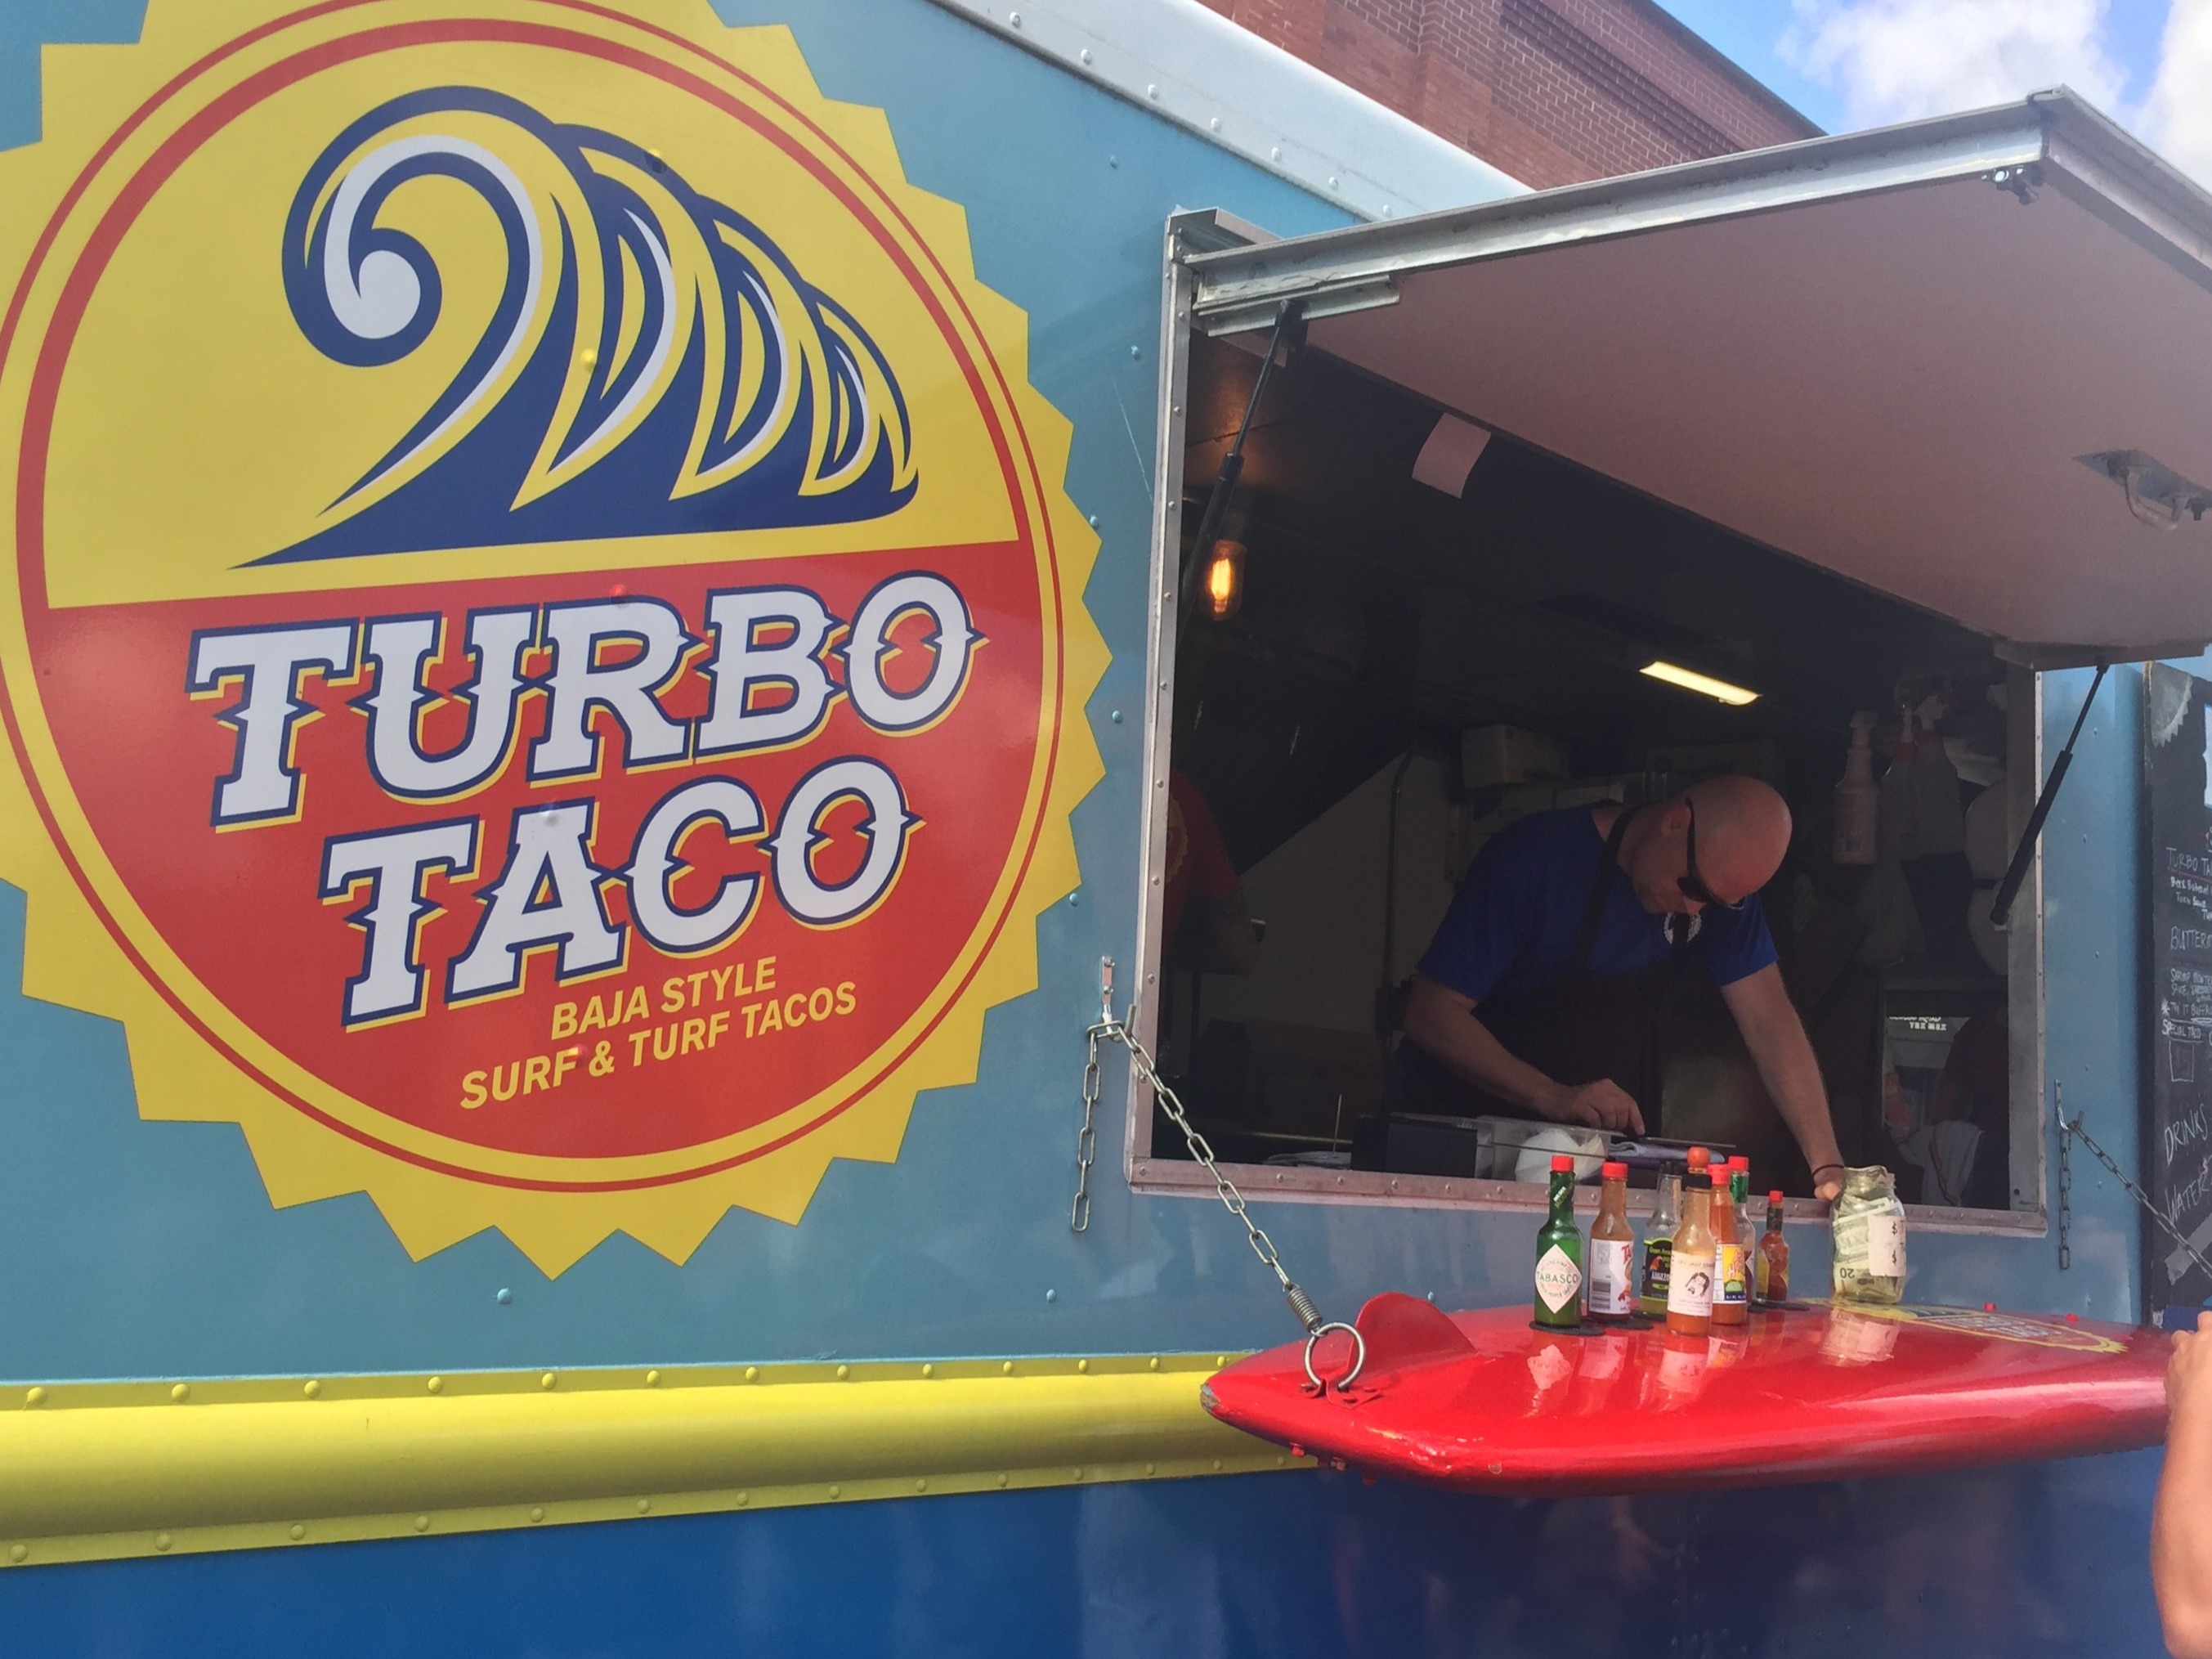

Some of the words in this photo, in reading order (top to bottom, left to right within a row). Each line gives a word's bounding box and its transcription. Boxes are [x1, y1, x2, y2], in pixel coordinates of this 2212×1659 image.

[185, 571, 988, 832] TURBO
[317, 755, 926, 1034] TACO
[2165, 846, 2198, 872] TURBO
[551, 985, 649, 1040] BAJA
[660, 956, 777, 1013] STYLE
[459, 1046, 580, 1110] SURF
[589, 1040, 616, 1077] &
[628, 1011, 731, 1067] TURF
[741, 981, 857, 1038] TACOS
[2165, 1103, 2208, 1166] DRINKS
[2165, 1170, 2209, 1223] WATER
[1537, 1271, 1578, 1285] TABASCO
